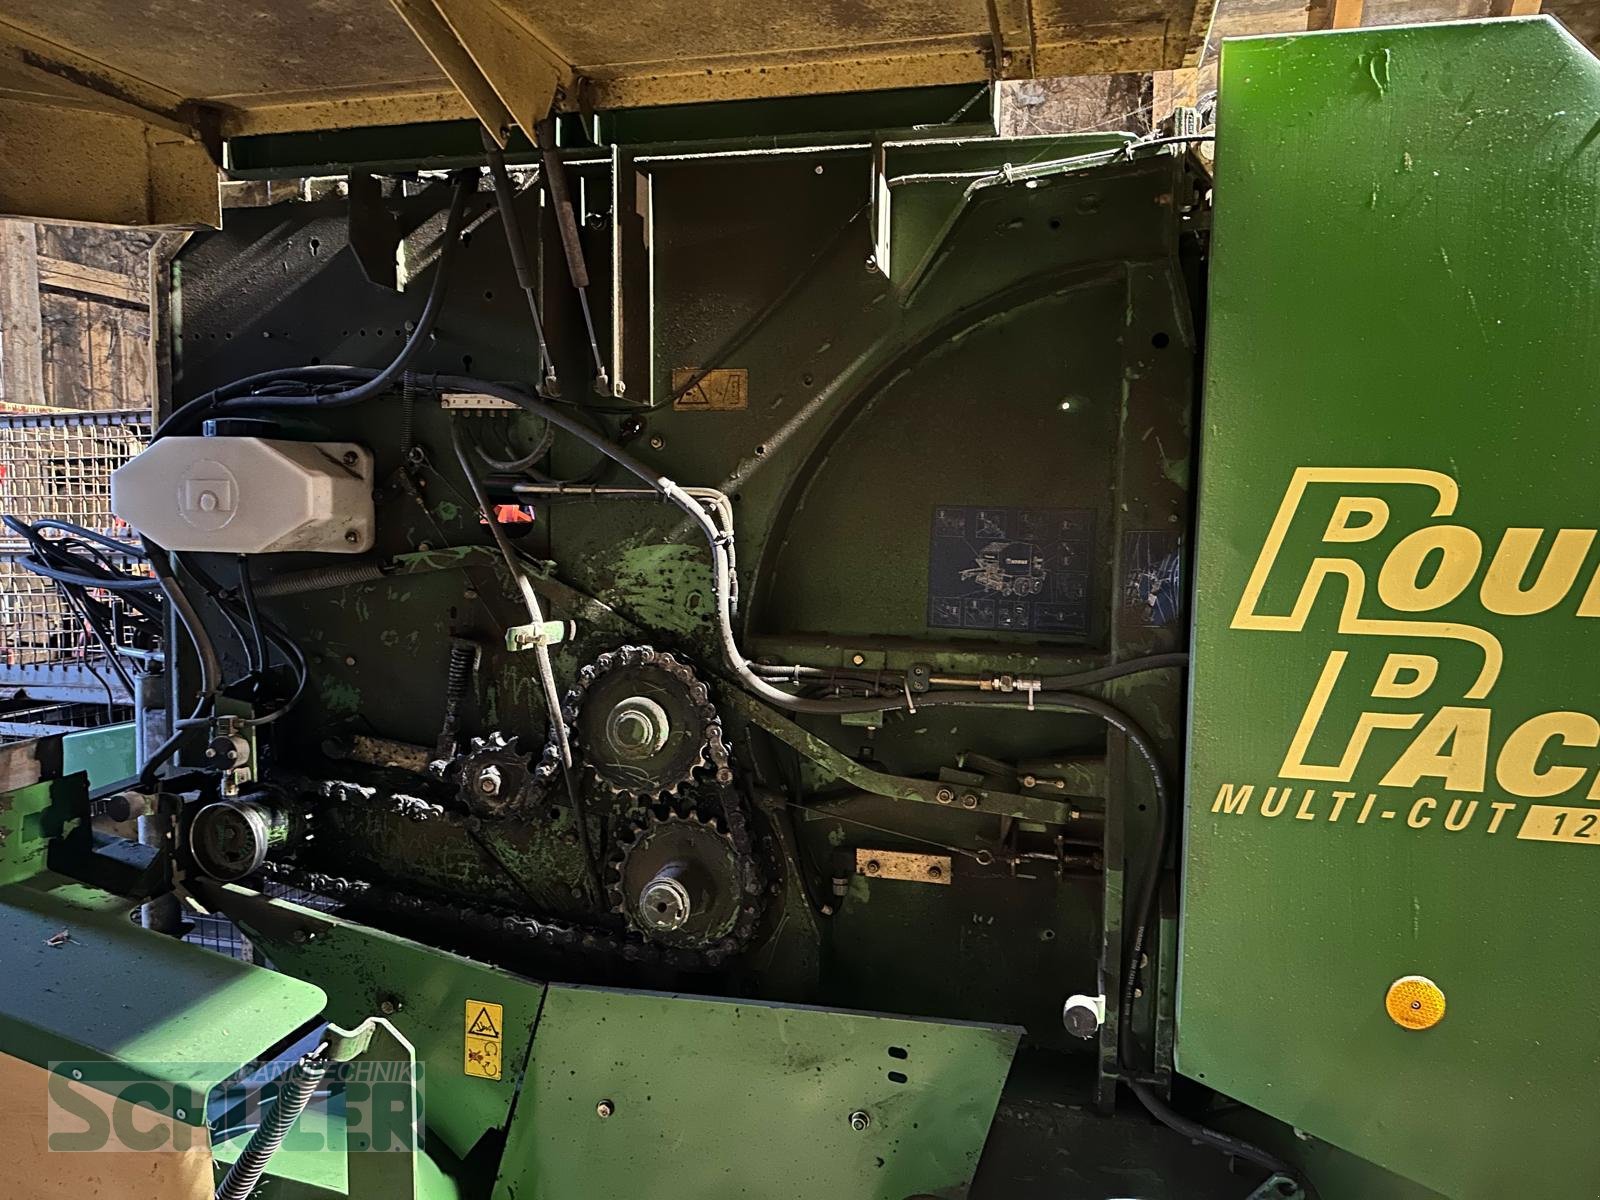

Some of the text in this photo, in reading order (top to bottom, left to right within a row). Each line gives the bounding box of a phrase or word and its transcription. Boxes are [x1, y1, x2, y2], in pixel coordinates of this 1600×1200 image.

[1230, 467, 1600, 634] ROU
[1278, 619, 1600, 800] PAC
[1211, 783, 1516, 834] MULTI-CUT
